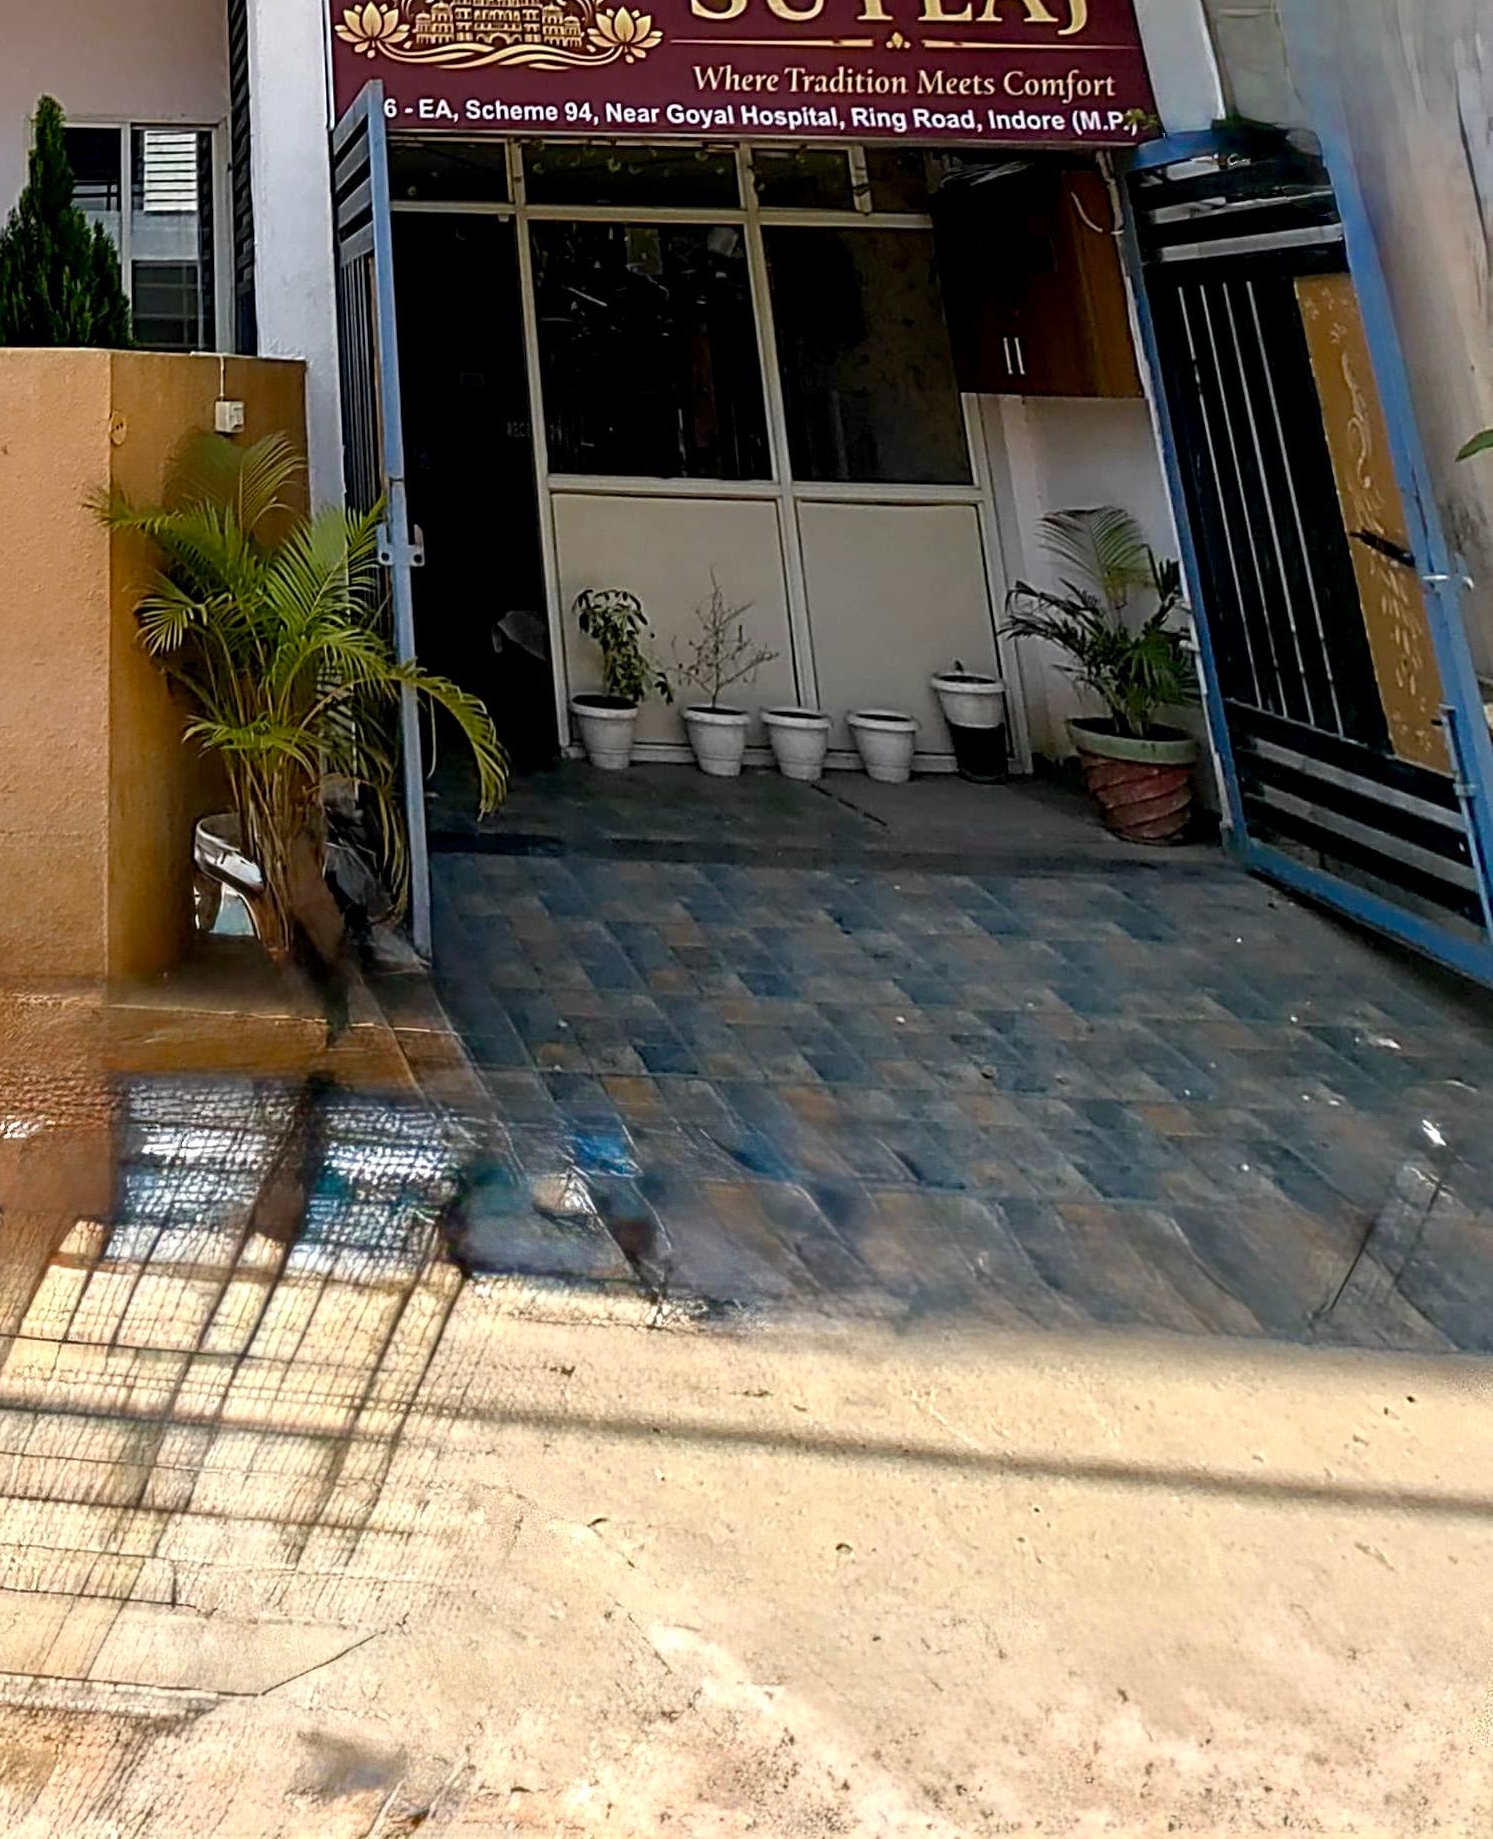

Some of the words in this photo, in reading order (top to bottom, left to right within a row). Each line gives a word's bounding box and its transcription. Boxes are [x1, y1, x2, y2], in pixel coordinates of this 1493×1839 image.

[693, 65, 779, 93] Where
[784, 67, 908, 95] Tradition
[917, 69, 996, 97] Meets
[1003, 69, 1117, 103] Comfort
[383, 98, 398, 118] 6
[418, 99, 459, 123] EA,
[465, 99, 558, 122] Scheme
[565, 102, 600, 127] 94,
[606, 103, 659, 124] Near
[666, 104, 734, 130] Goyal
[740, 106, 846, 130] Hospital,
[851, 108, 907, 133] Ring
[914, 109, 983, 133] Road,
[989, 110, 1066, 131] Indore
